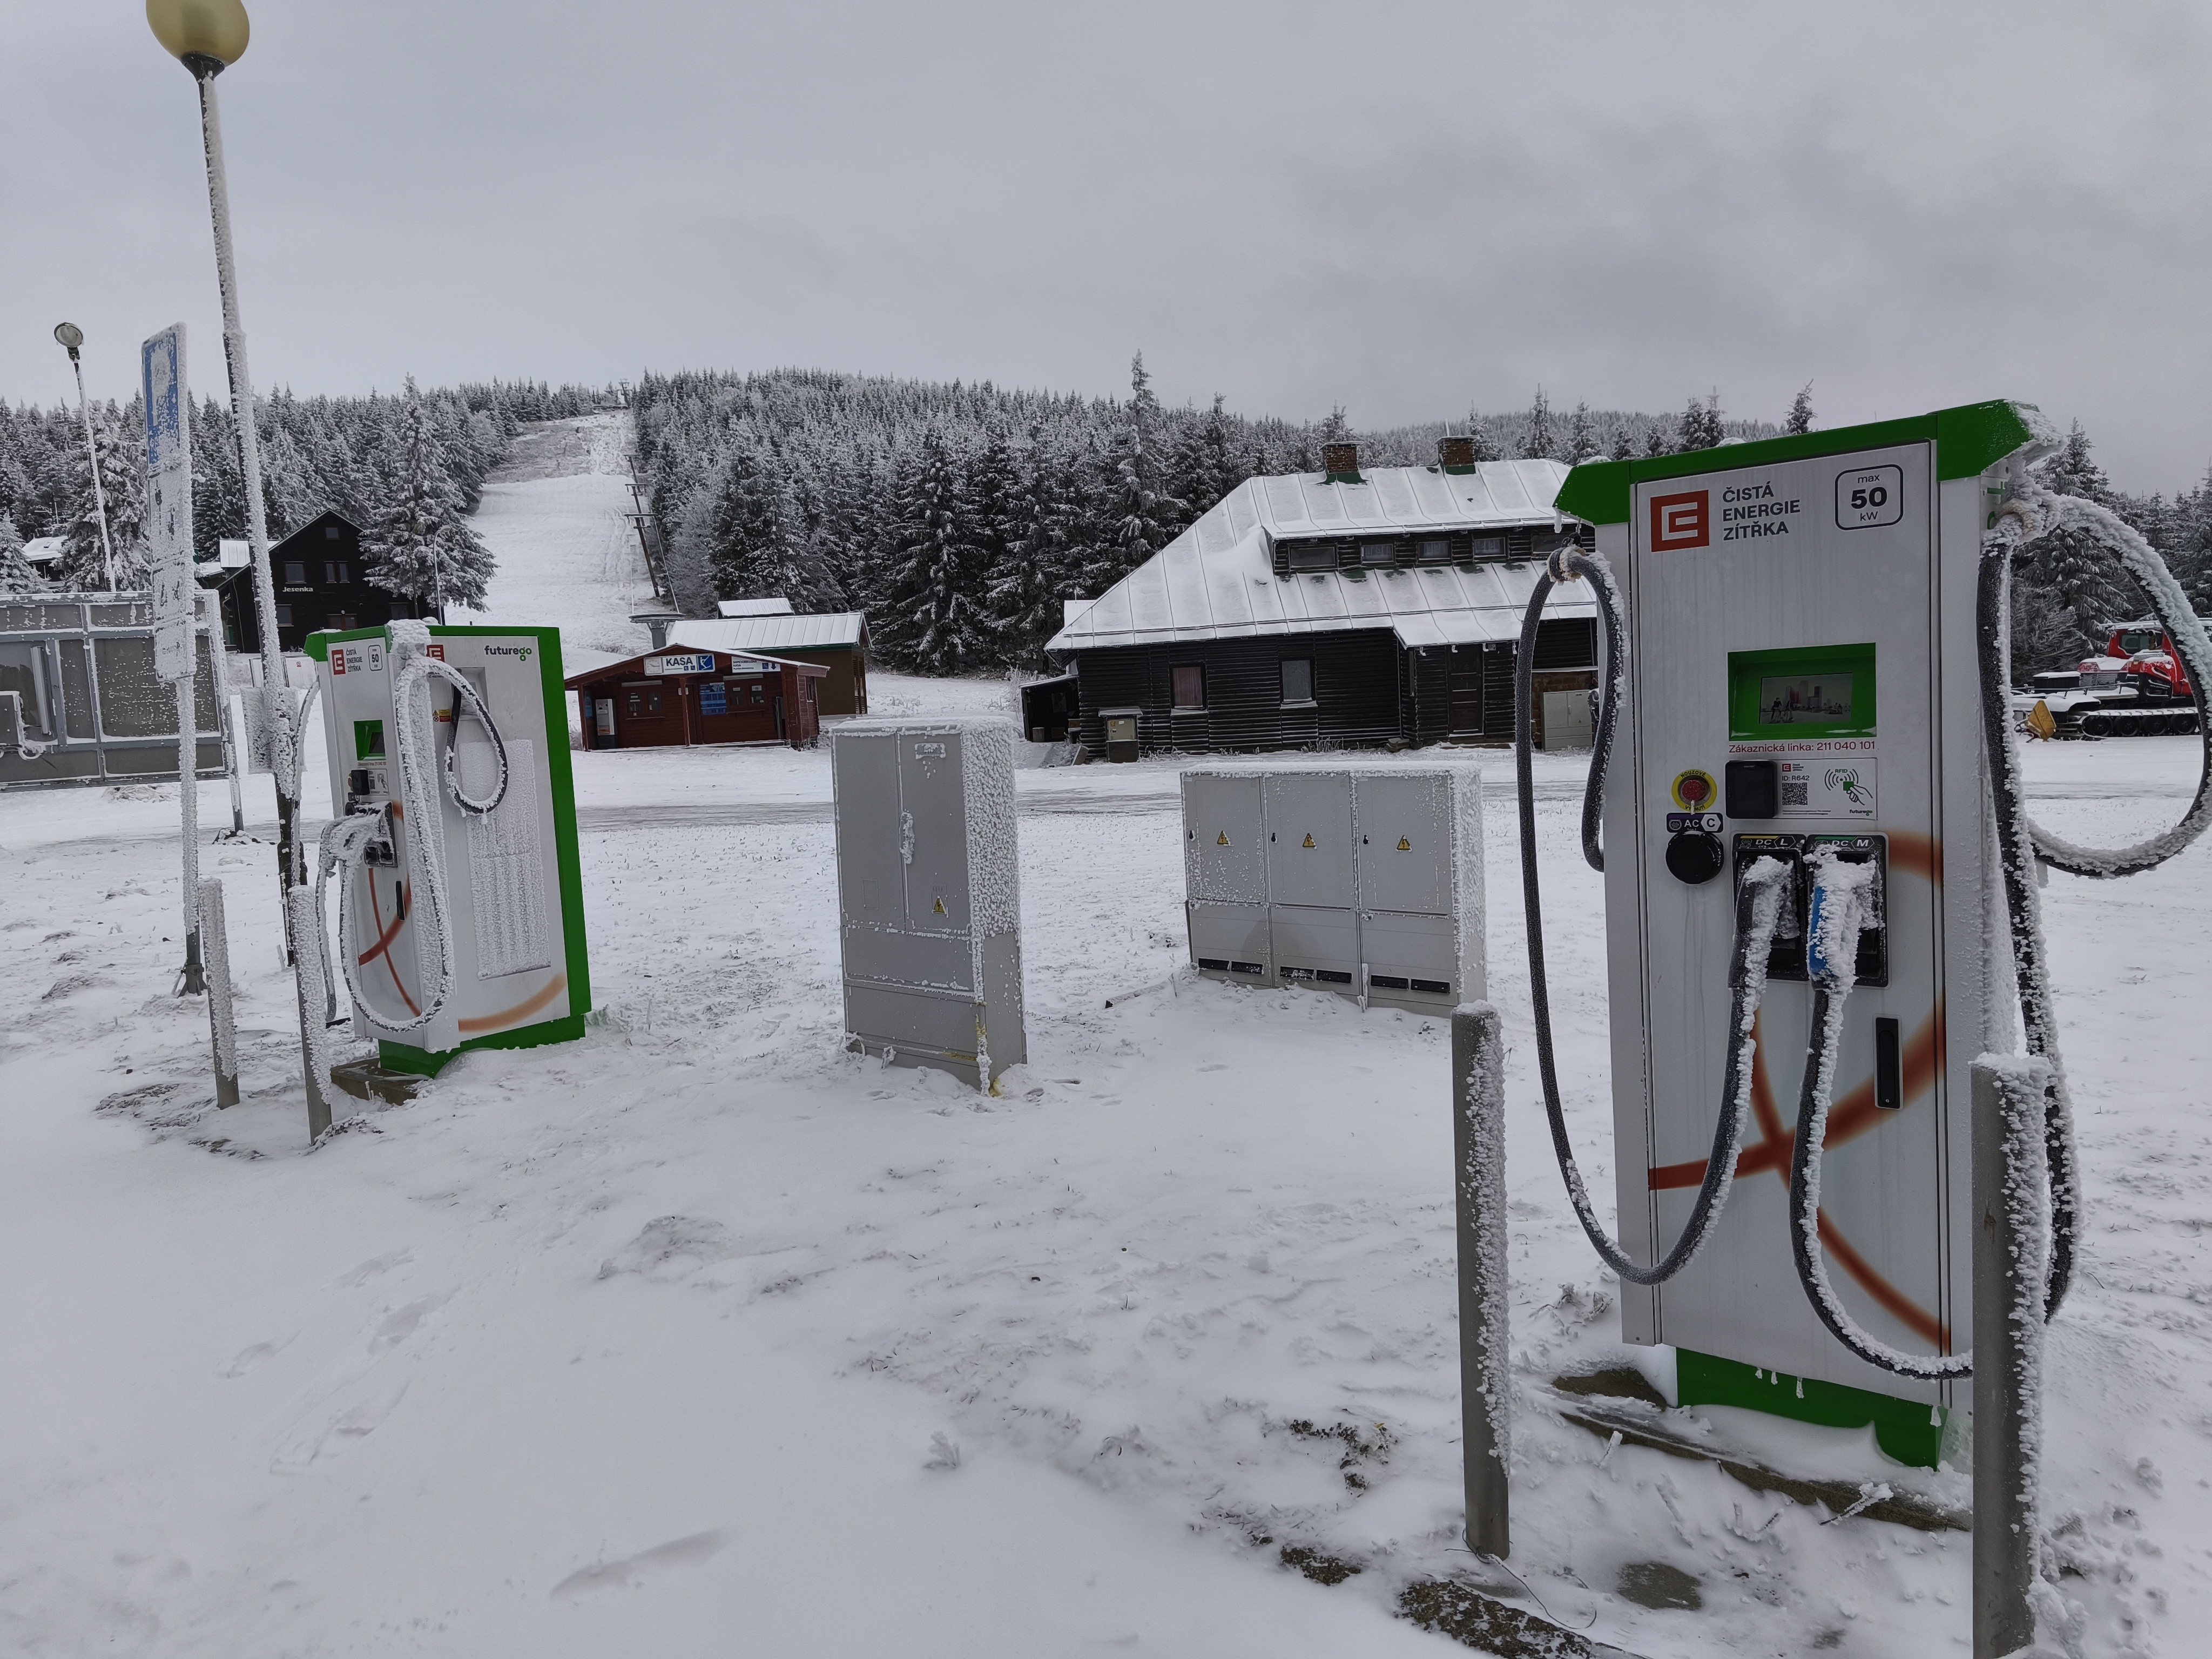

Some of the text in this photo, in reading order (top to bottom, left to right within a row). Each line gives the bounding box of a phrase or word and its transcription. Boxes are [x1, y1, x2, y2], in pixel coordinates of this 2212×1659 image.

[1857, 474, 1880, 483] max
[1722, 481, 1775, 503] ČISTÁ
[1851, 487, 1887, 510] 50
[1722, 500, 1800, 522] ENERGIE
[1859, 510, 1879, 522] kW
[1723, 520, 1789, 541] ZÍTŘKA
[372, 654, 379, 663] 50
[484, 645, 532, 662] futurego
[666, 657, 693, 666] KASA
[1729, 741, 1876, 753] Zákaznická linka: 211 040 101
[1680, 770, 1706, 778] NOUZOVÉ
[1707, 818, 1715, 827] C
